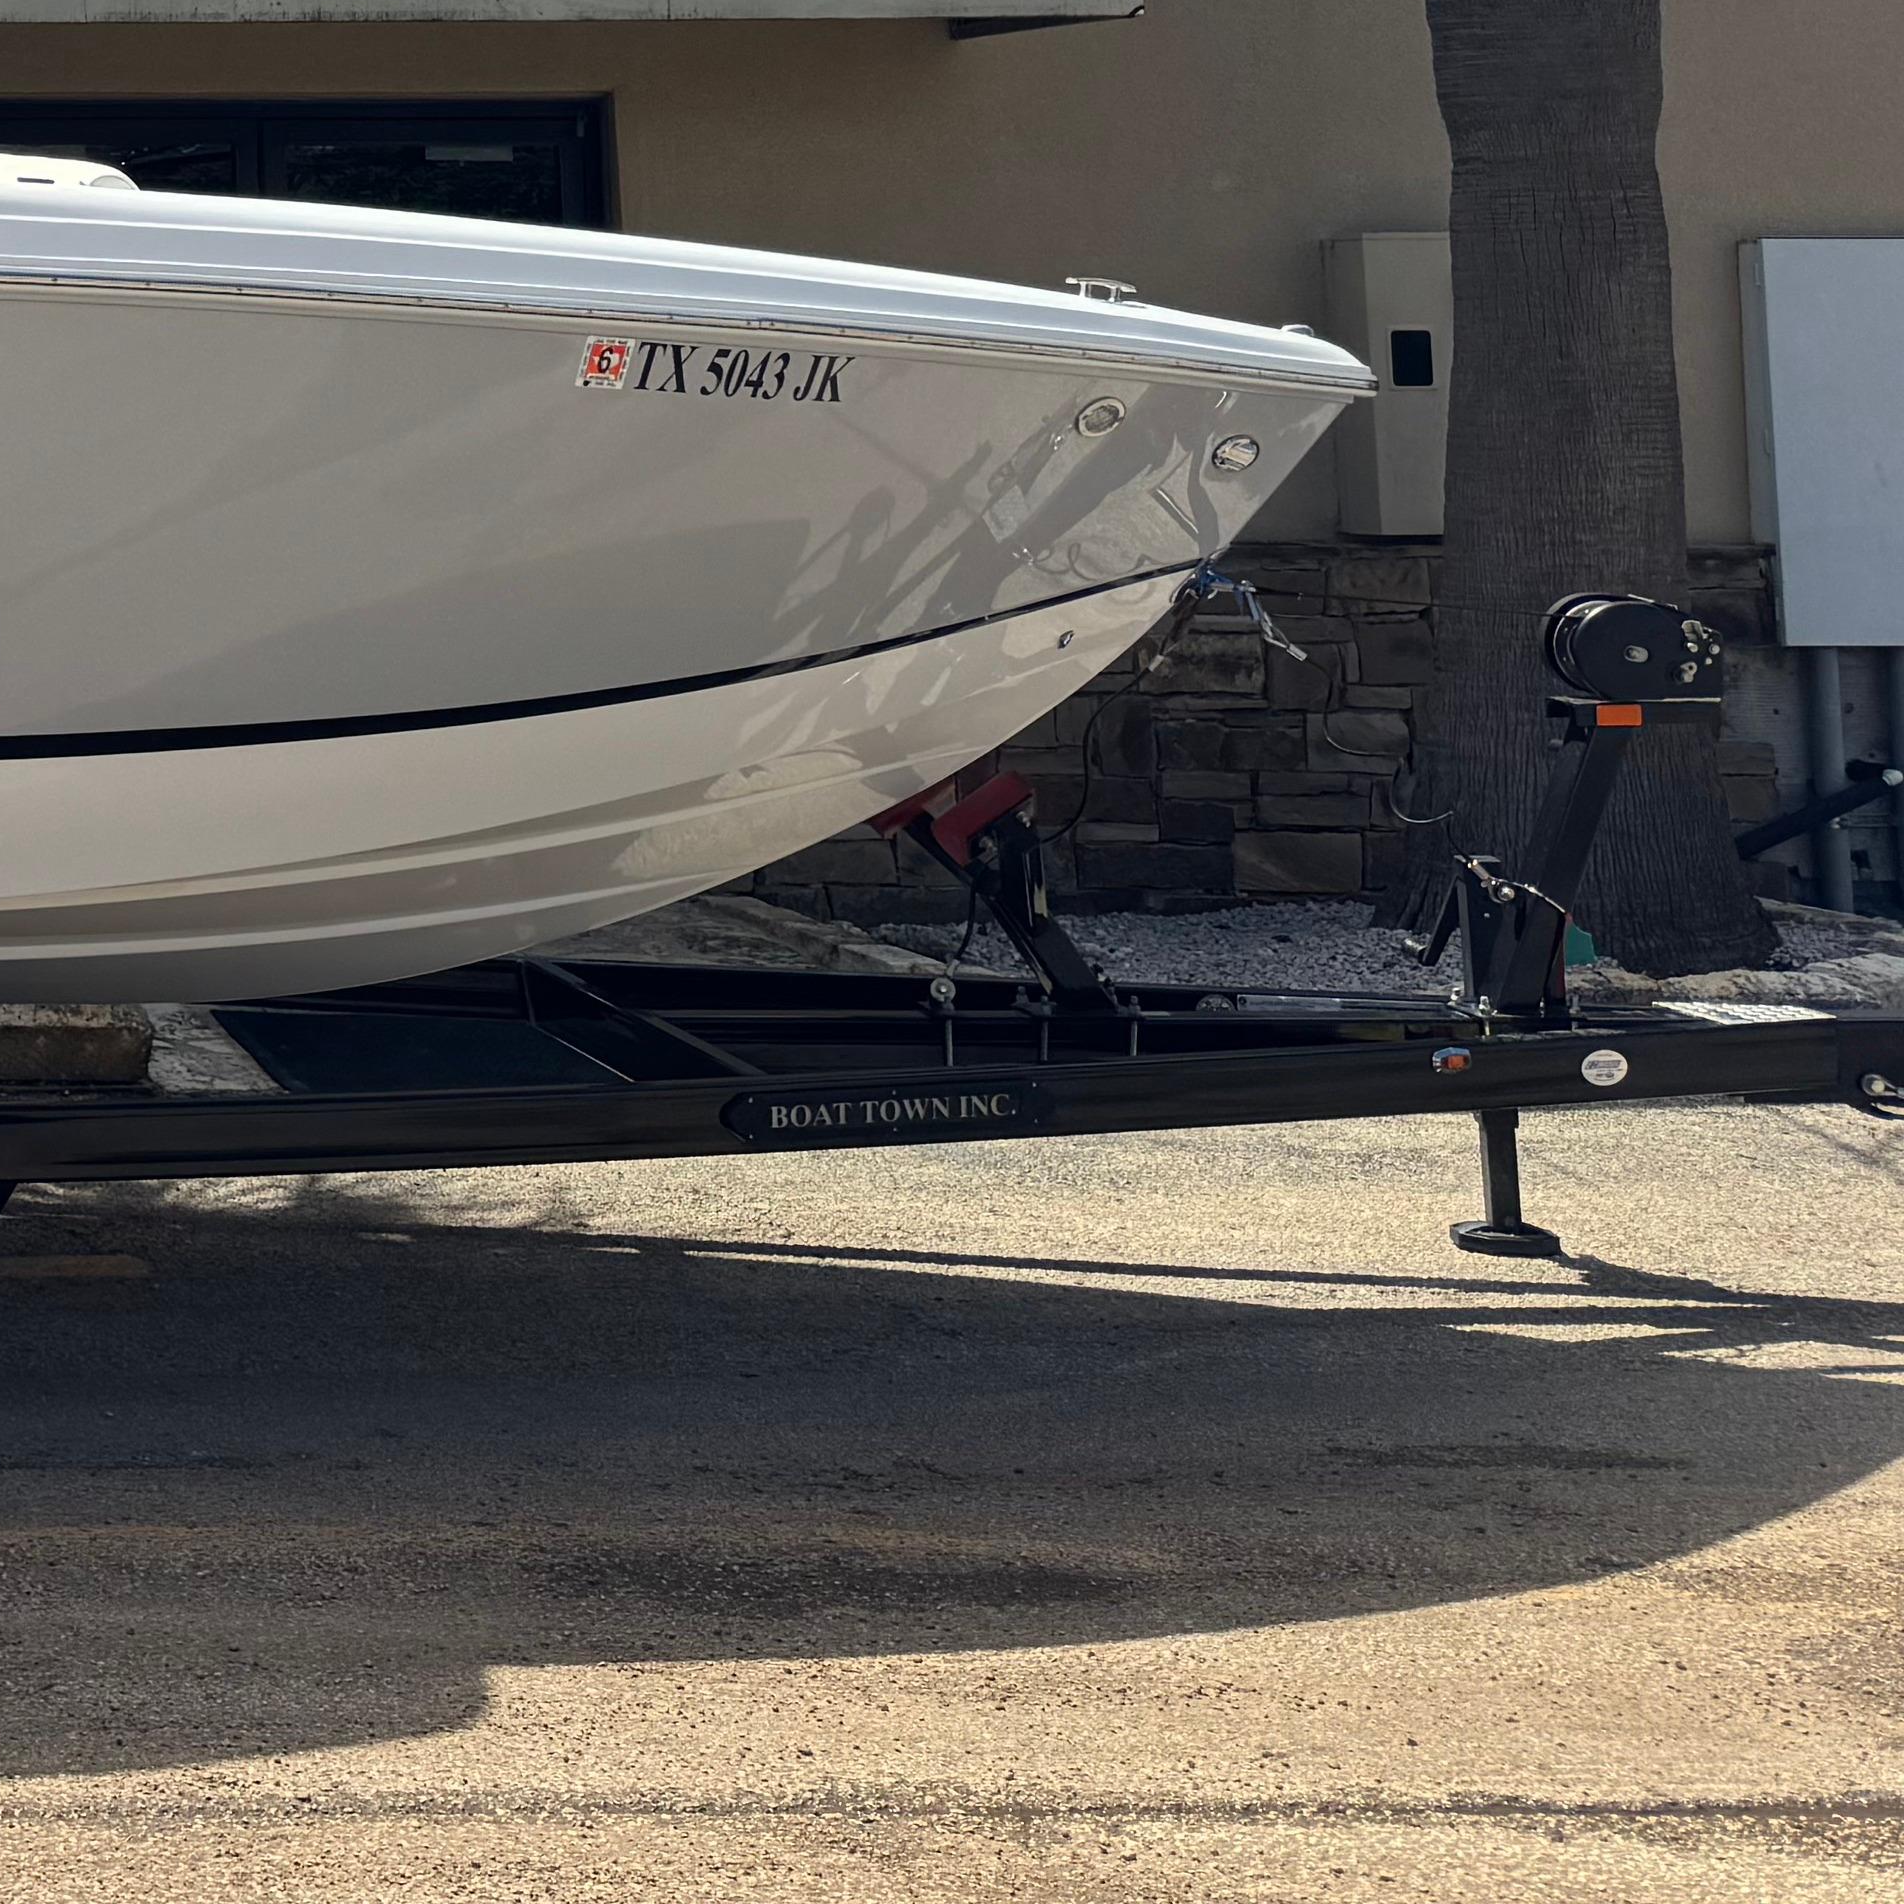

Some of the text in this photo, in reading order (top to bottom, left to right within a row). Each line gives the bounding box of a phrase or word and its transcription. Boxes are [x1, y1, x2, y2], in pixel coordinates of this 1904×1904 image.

[633, 341, 700, 394] TX
[699, 348, 791, 400] 5043
[793, 354, 856, 403] JK
[770, 1093, 1017, 1129] BOAT TOWN INC.
